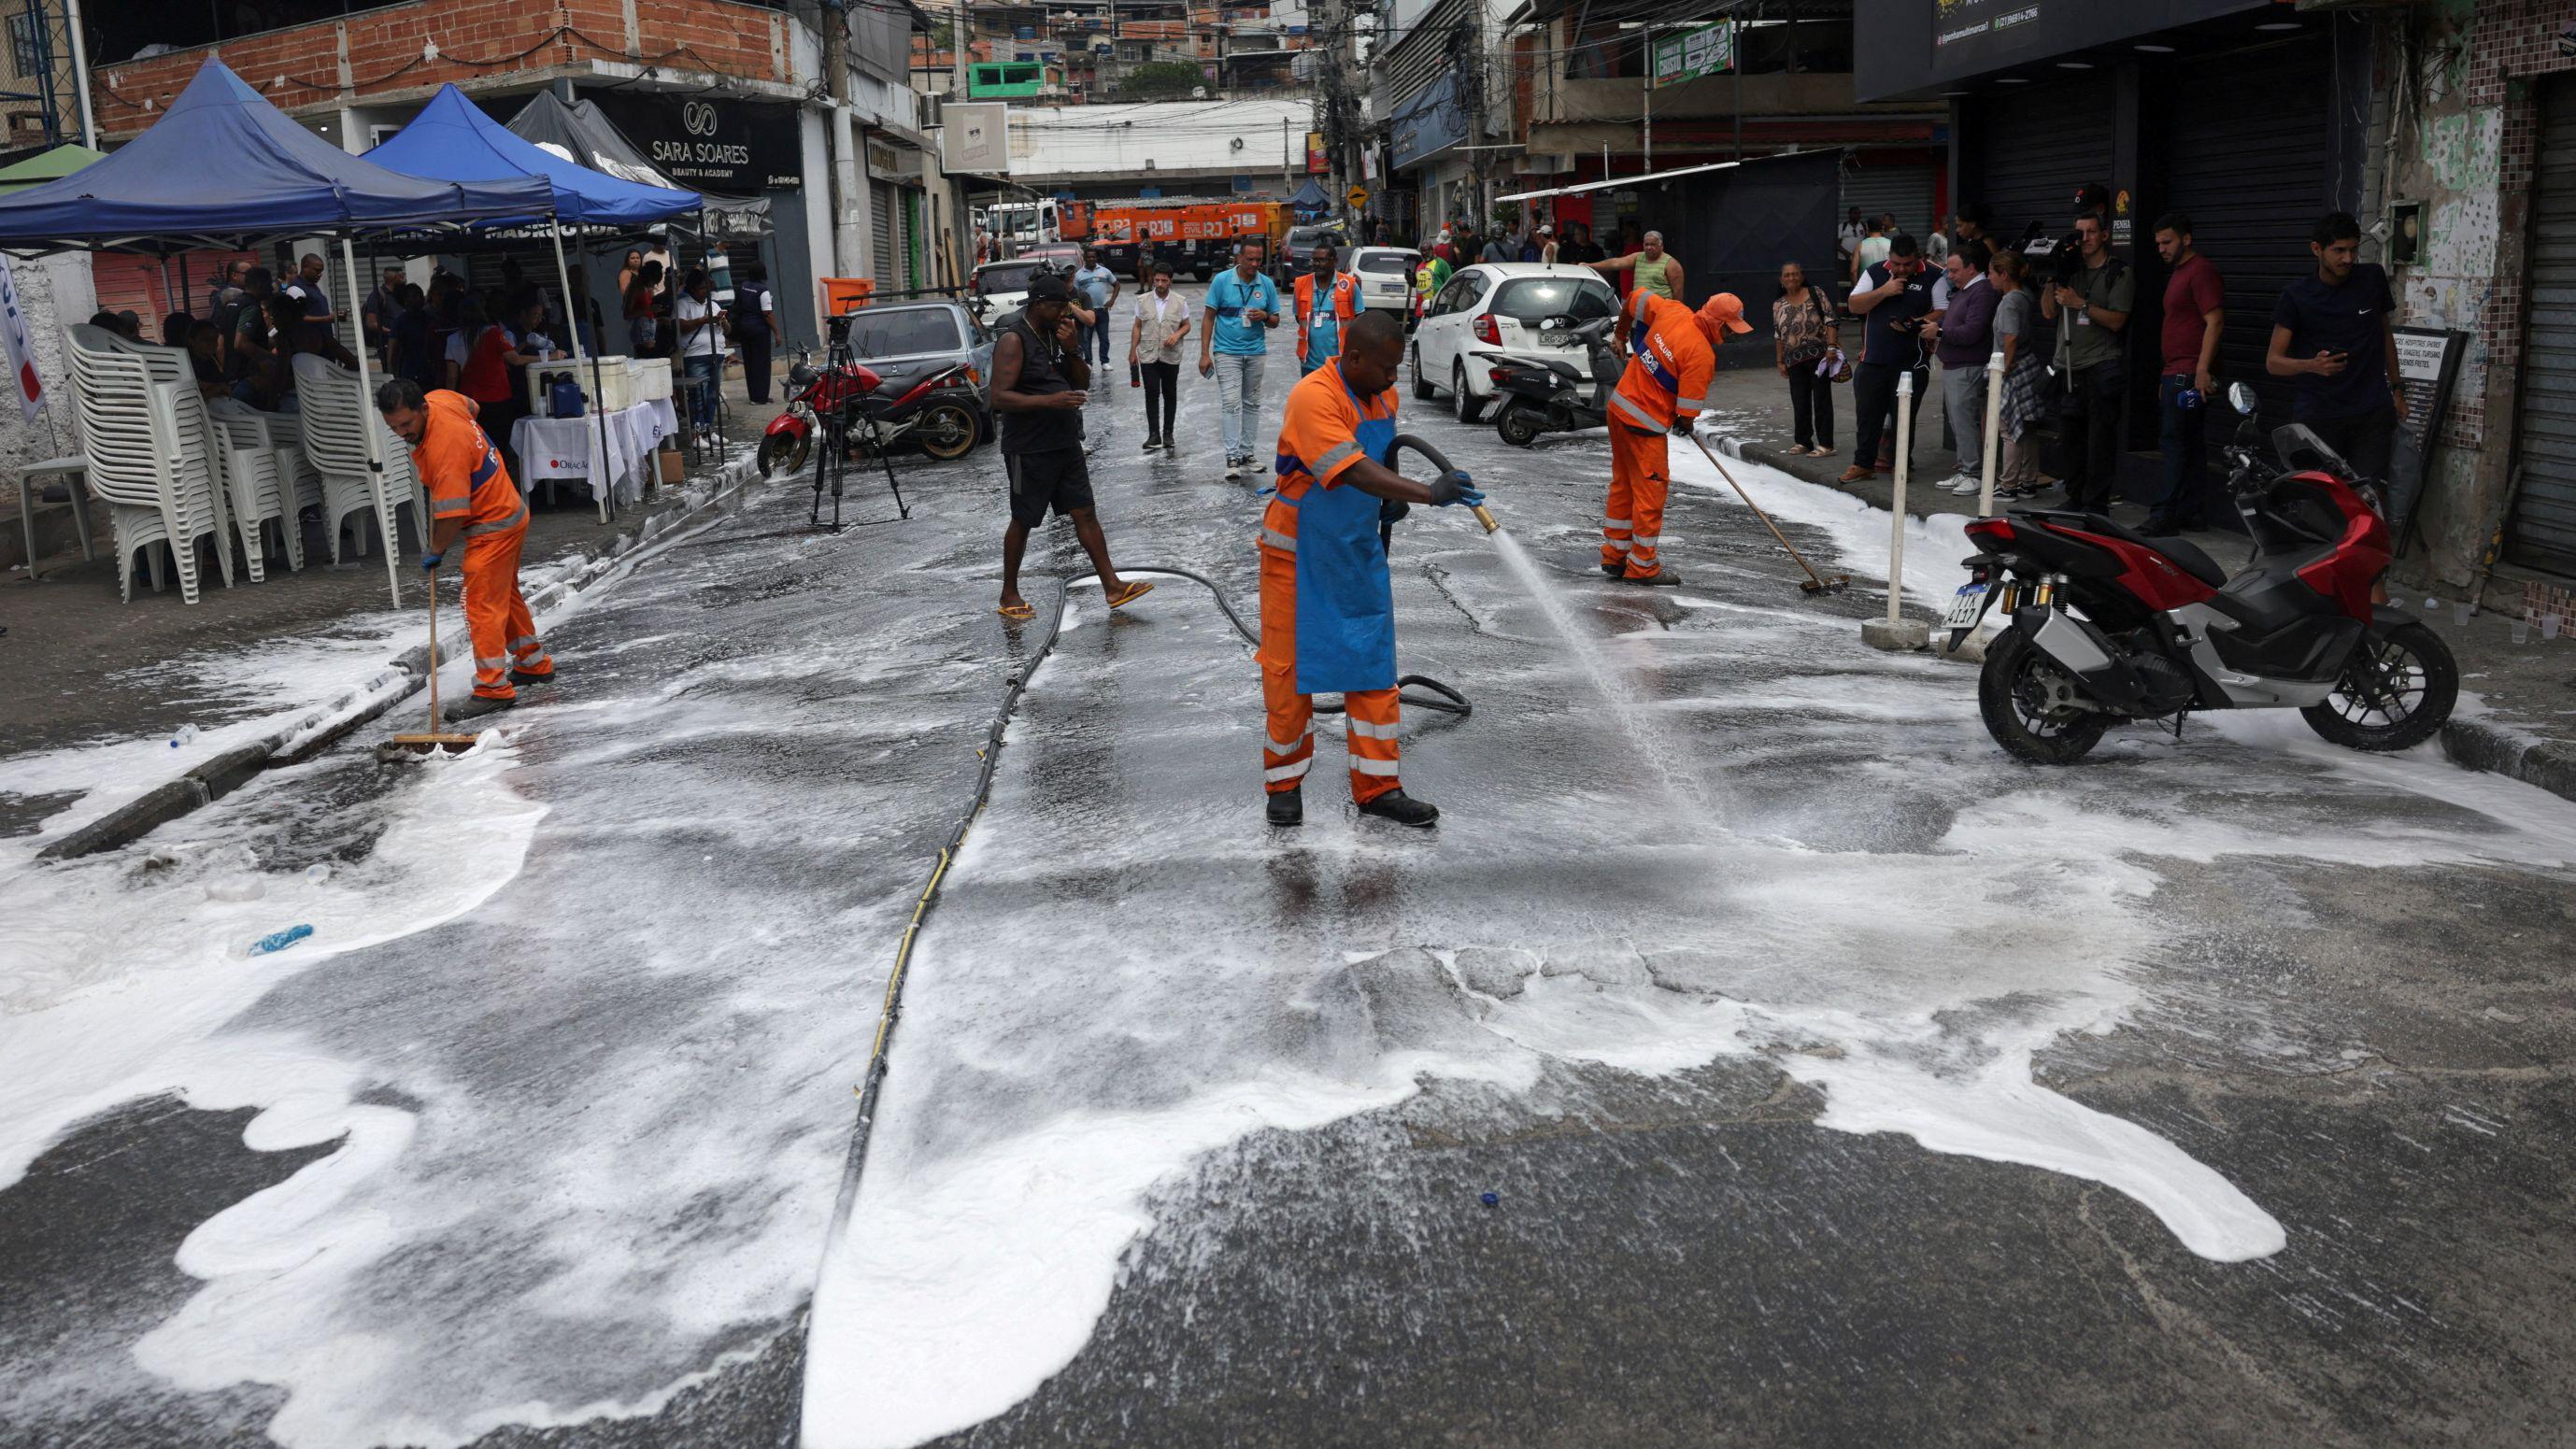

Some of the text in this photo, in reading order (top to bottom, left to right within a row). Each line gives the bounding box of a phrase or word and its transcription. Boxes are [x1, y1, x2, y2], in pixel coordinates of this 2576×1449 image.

[653, 140, 748, 164] SARA SOARES
[672, 167, 697, 178] BEAUTY
[704, 169, 733, 178] ACADEMY
